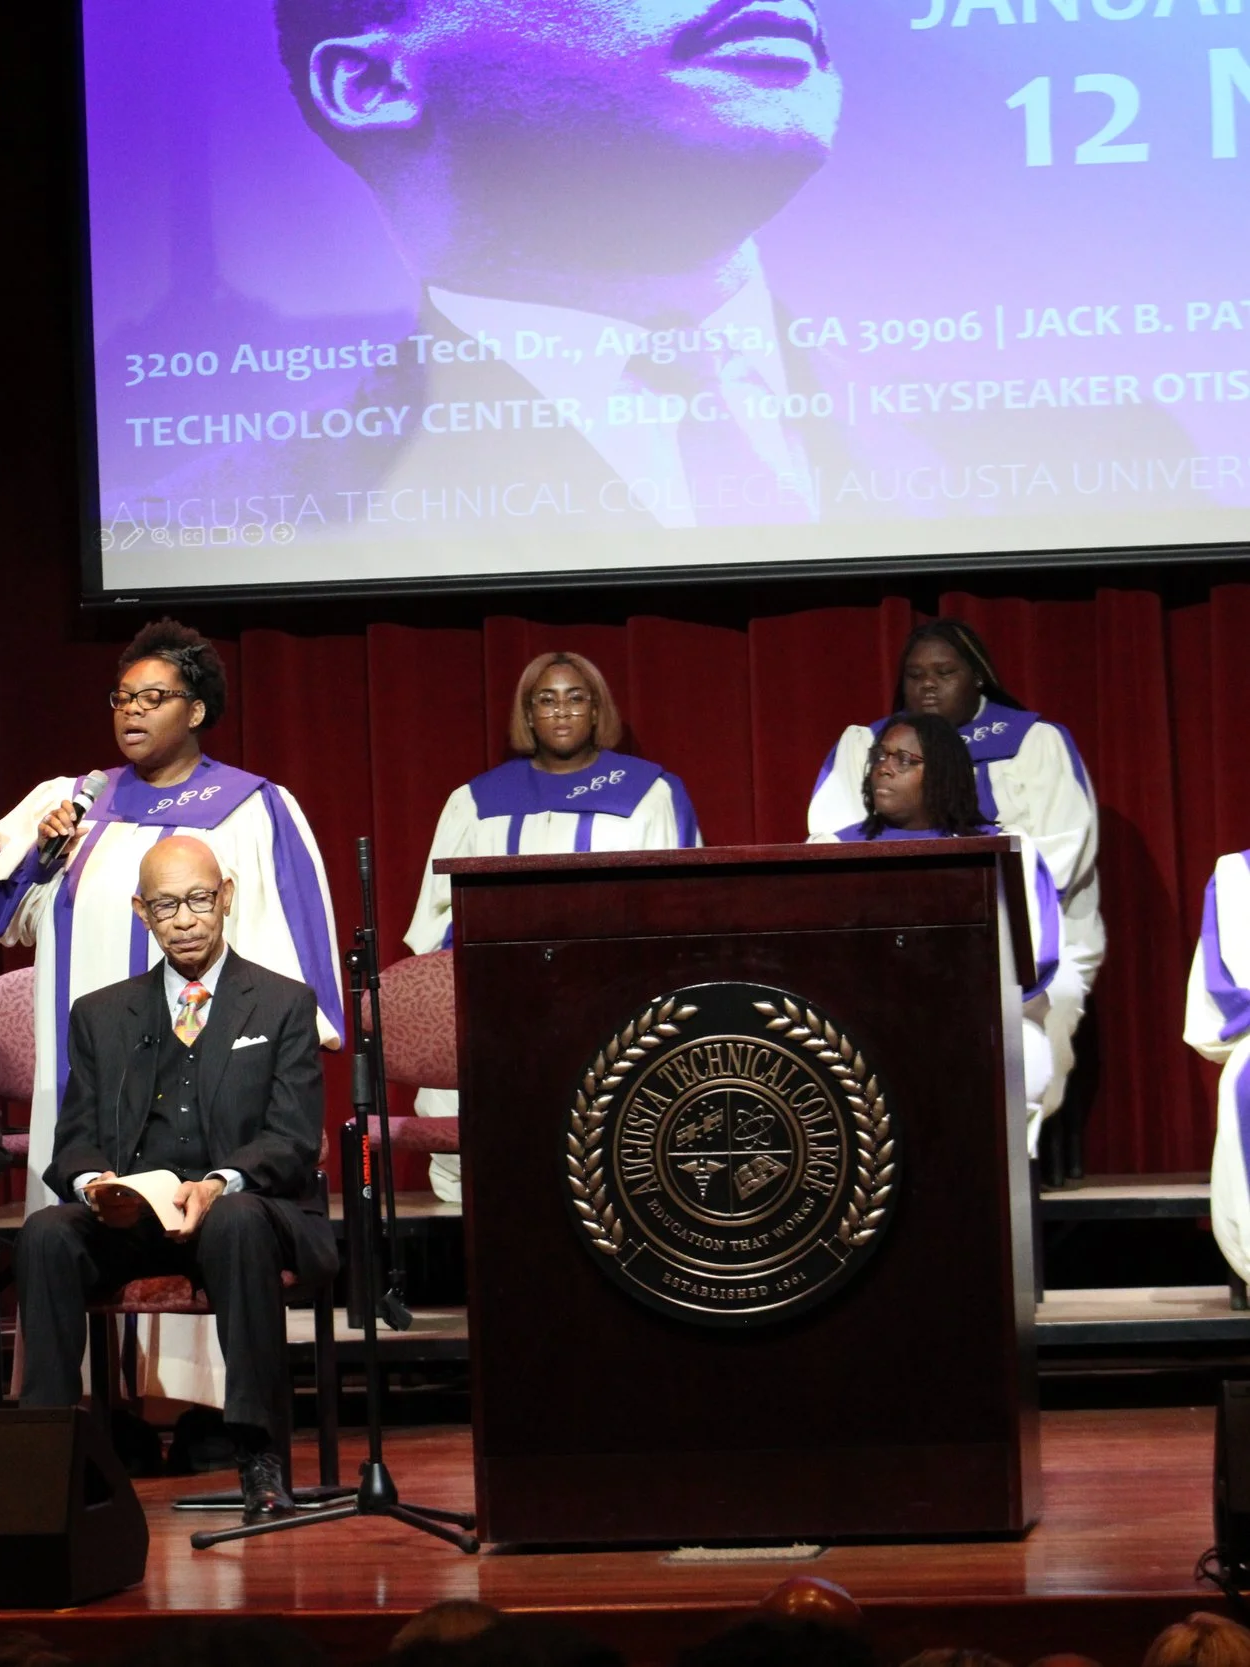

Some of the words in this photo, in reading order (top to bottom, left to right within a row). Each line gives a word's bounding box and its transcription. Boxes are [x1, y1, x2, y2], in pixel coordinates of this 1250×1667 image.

[1005, 73, 1150, 167] 12
[125, 350, 219, 386] 3200
[230, 338, 397, 381] Augusta
[408, 330, 502, 366] Tech
[514, 329, 583, 364] Dr.,
[595, 322, 776, 364] Augusta,
[787, 316, 847, 348] GA
[858, 310, 983, 352] 30906
[1016, 304, 1122, 340] JACK
[1134, 303, 1173, 334] B.
[126, 405, 410, 447] TECHNOLOGY
[421, 397, 594, 434] CENTER,
[607, 391, 731, 425] BLDG.
[743, 391, 833, 420] 1000
[870, 375, 1139, 414] KEYSPEAKER
[1153, 369, 1250, 404] OTIS
[108, 492, 327, 534] AUGUSTA
[336, 481, 585, 524] TECHNICAL
[598, 471, 799, 513] COLLEGE
[834, 461, 1060, 502] AUGUSTA
[1072, 455, 1250, 495] UNIVER
[620, 1087, 673, 1197] AUGUSTA
[656, 1041, 800, 1098] TECHNICAL
[788, 1082, 841, 1197] COLLEGE
[647, 1198, 726, 1252] EDUCATION
[729, 1232, 771, 1252] THAT
[771, 1196, 817, 1240] WORKS
[661, 1271, 769, 1300] ESTABLISHED
[775, 1271, 808, 1293] 1961
